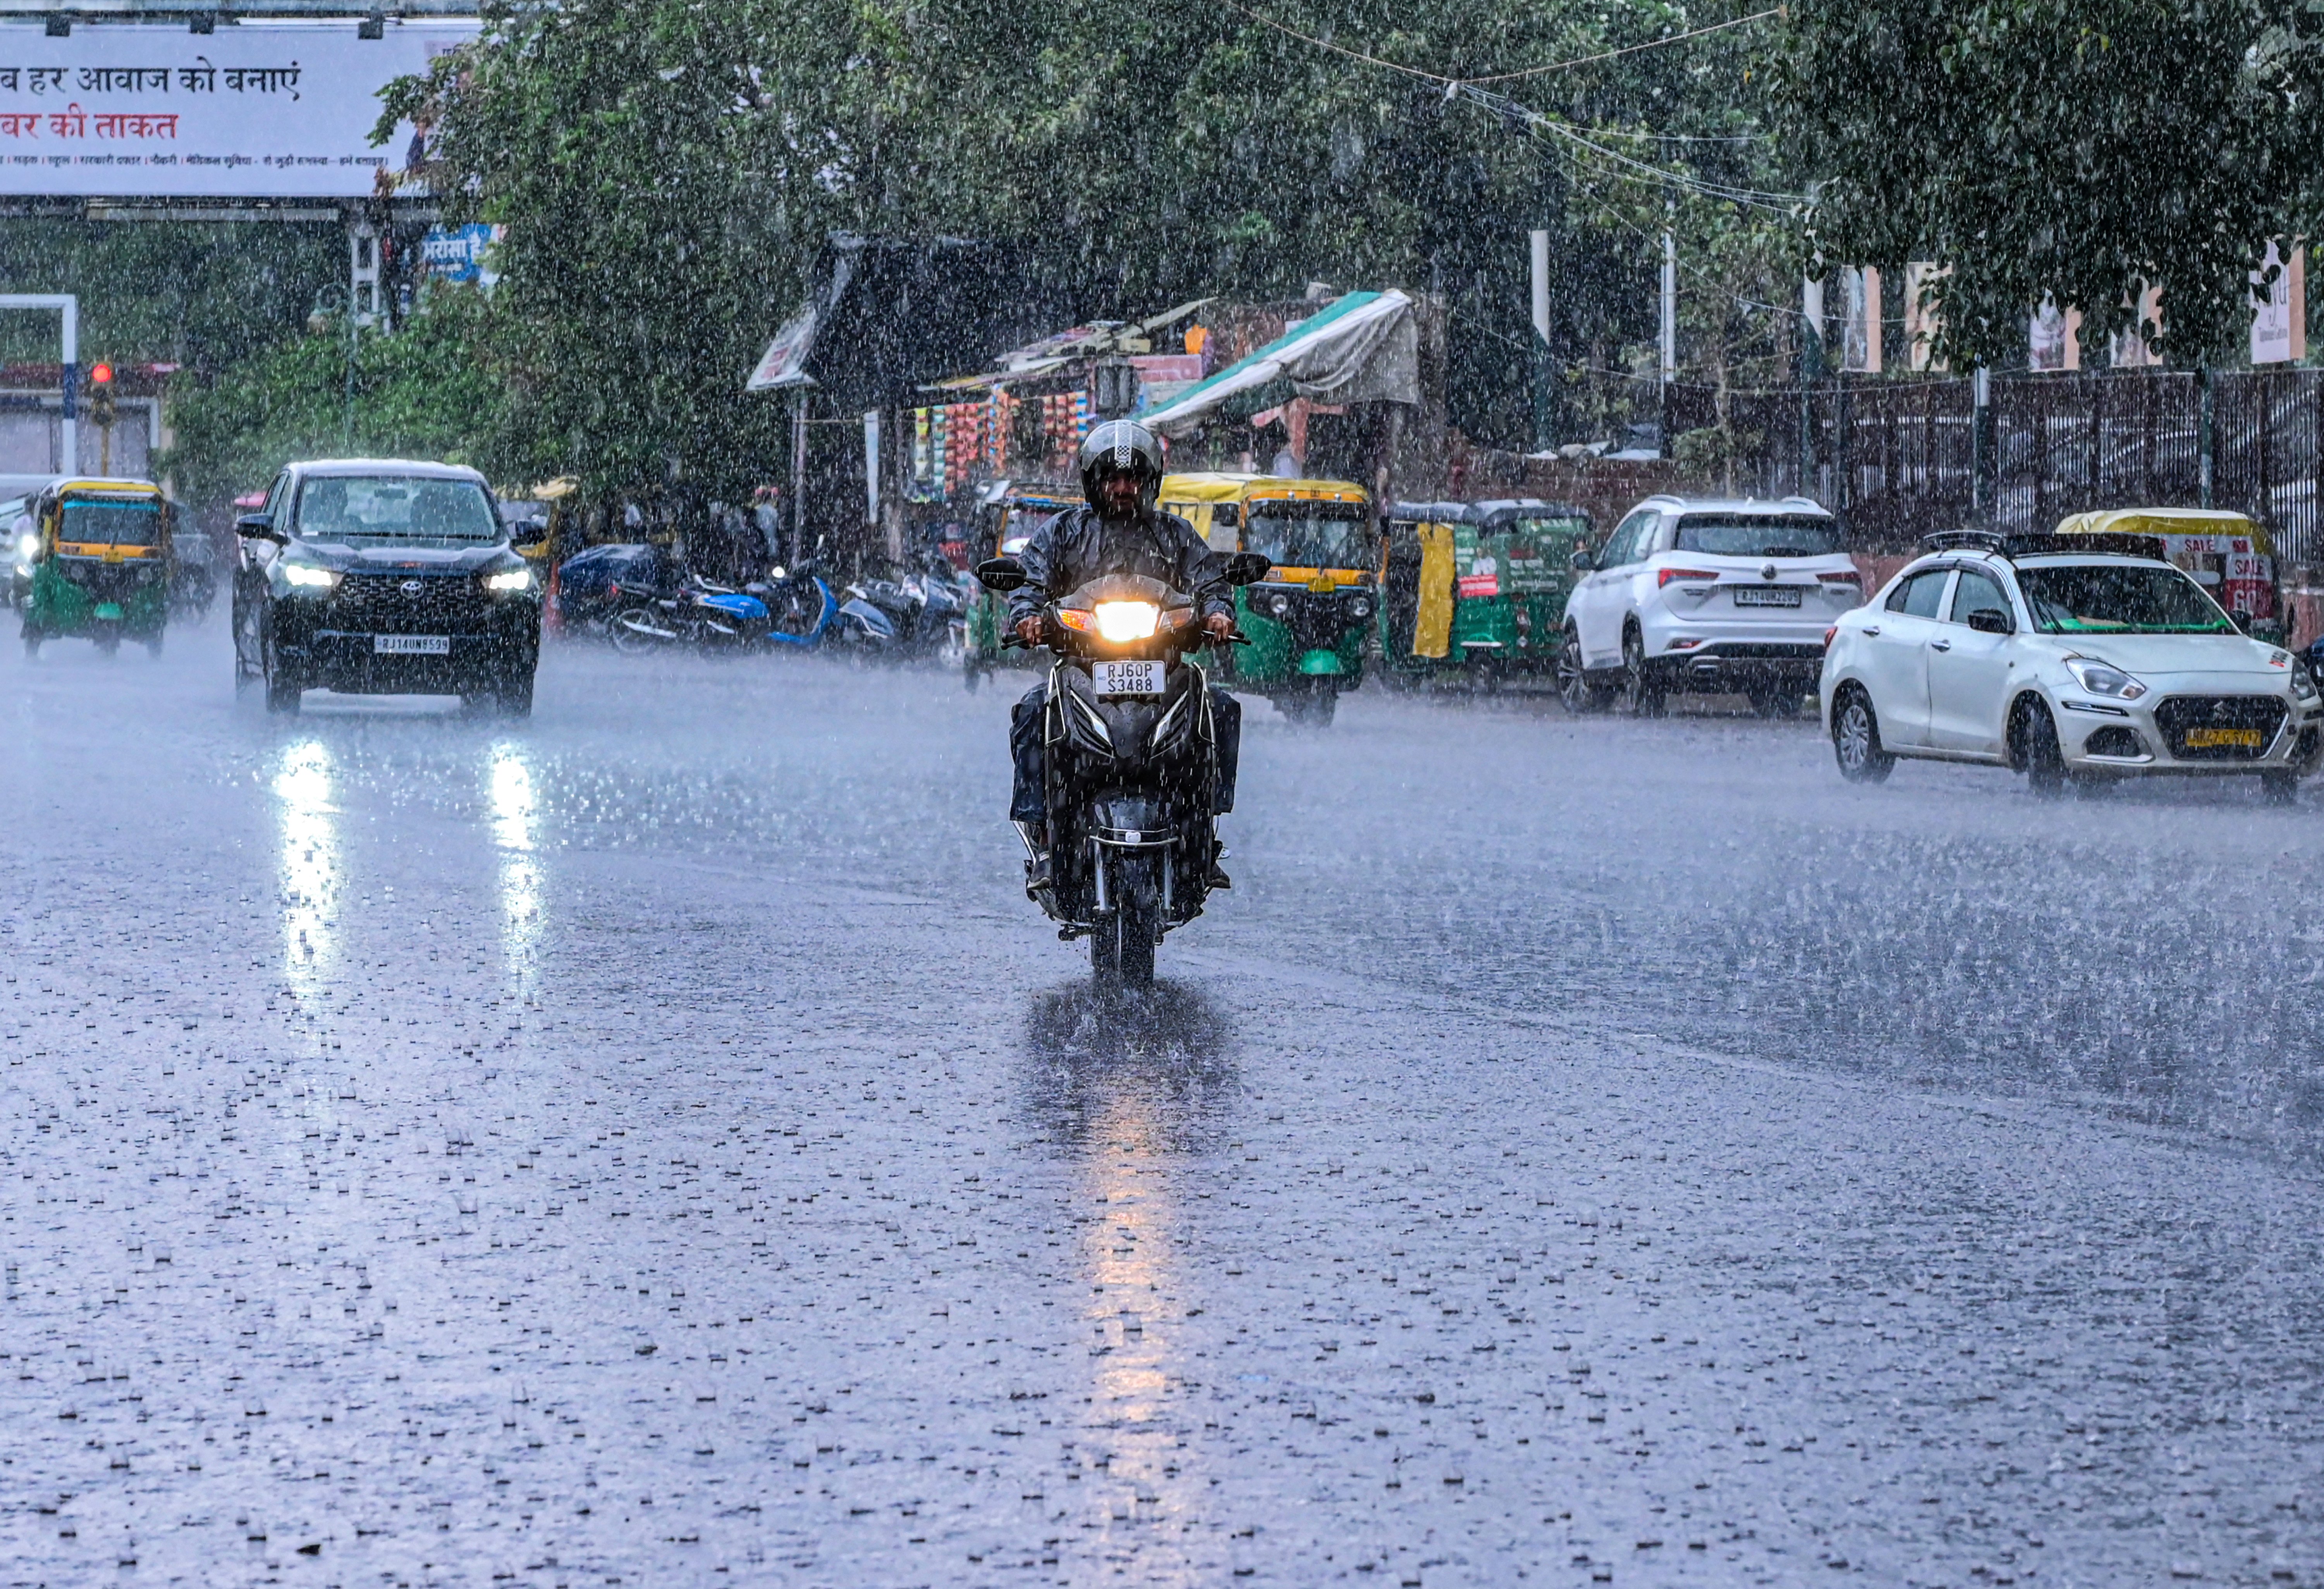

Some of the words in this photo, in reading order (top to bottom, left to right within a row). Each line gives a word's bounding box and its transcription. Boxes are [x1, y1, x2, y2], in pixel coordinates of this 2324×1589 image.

[27, 68, 69, 95] हर
[77, 68, 172, 93] आवाज
[178, 55, 216, 93] को
[48, 102, 88, 138] की
[94, 113, 179, 139] ताकत
[2185, 539, 2215, 551] SALE
[2235, 559, 2264, 576] SALE
[1108, 664, 1152, 678] RJ60P
[1108, 678, 1152, 692] S3488
